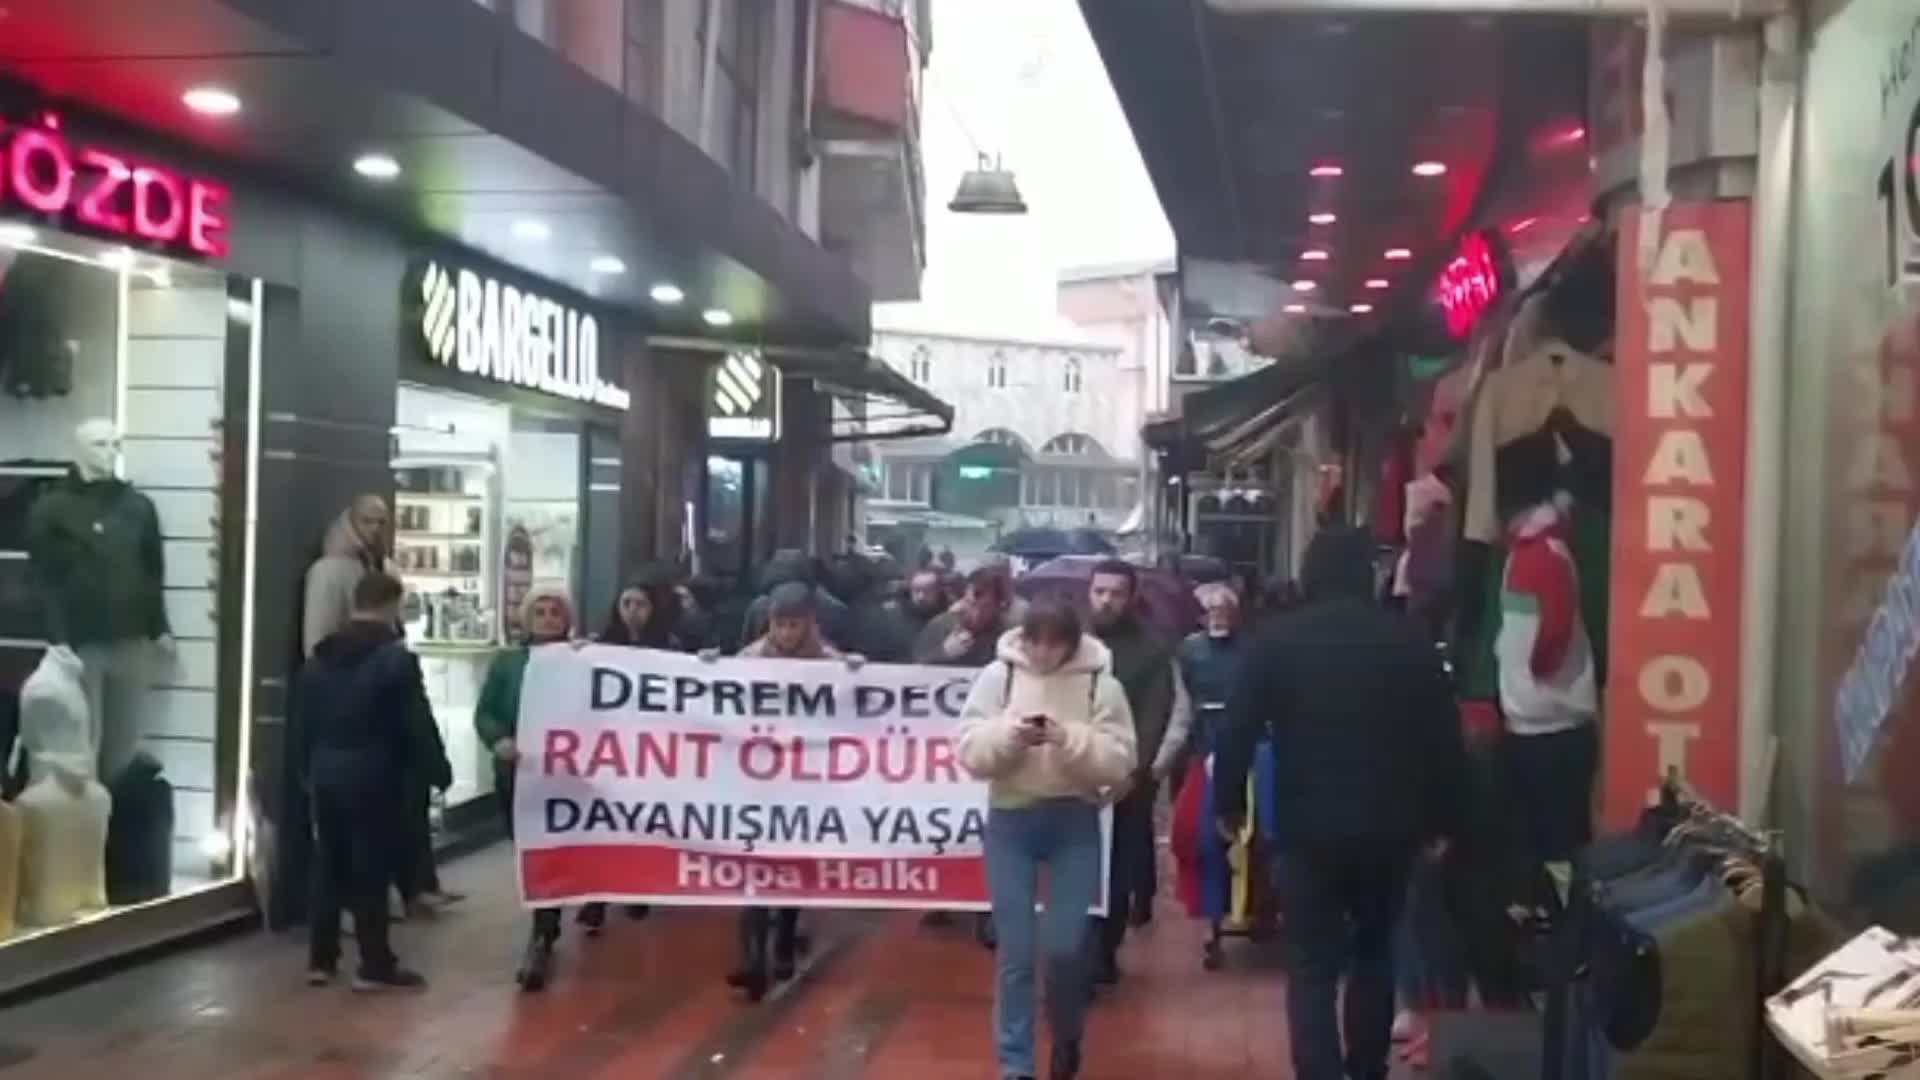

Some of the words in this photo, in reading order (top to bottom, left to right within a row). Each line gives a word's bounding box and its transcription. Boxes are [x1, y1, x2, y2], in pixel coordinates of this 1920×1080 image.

[0, 112, 231, 257] ÖZDE
[457, 268, 598, 402] BARGELLO
[1638, 229, 1720, 621] ANKARA
[590, 667, 836, 717] DEPREM
[855, 676, 969, 719] DEĞ
[543, 730, 721, 779] RANT
[738, 724, 984, 783] ÖLDÜR
[545, 798, 848, 852] DAYANIŞMA
[862, 807, 985, 855] YAŞA
[678, 855, 803, 896] Hopa
[818, 856, 938, 893] Halkı
